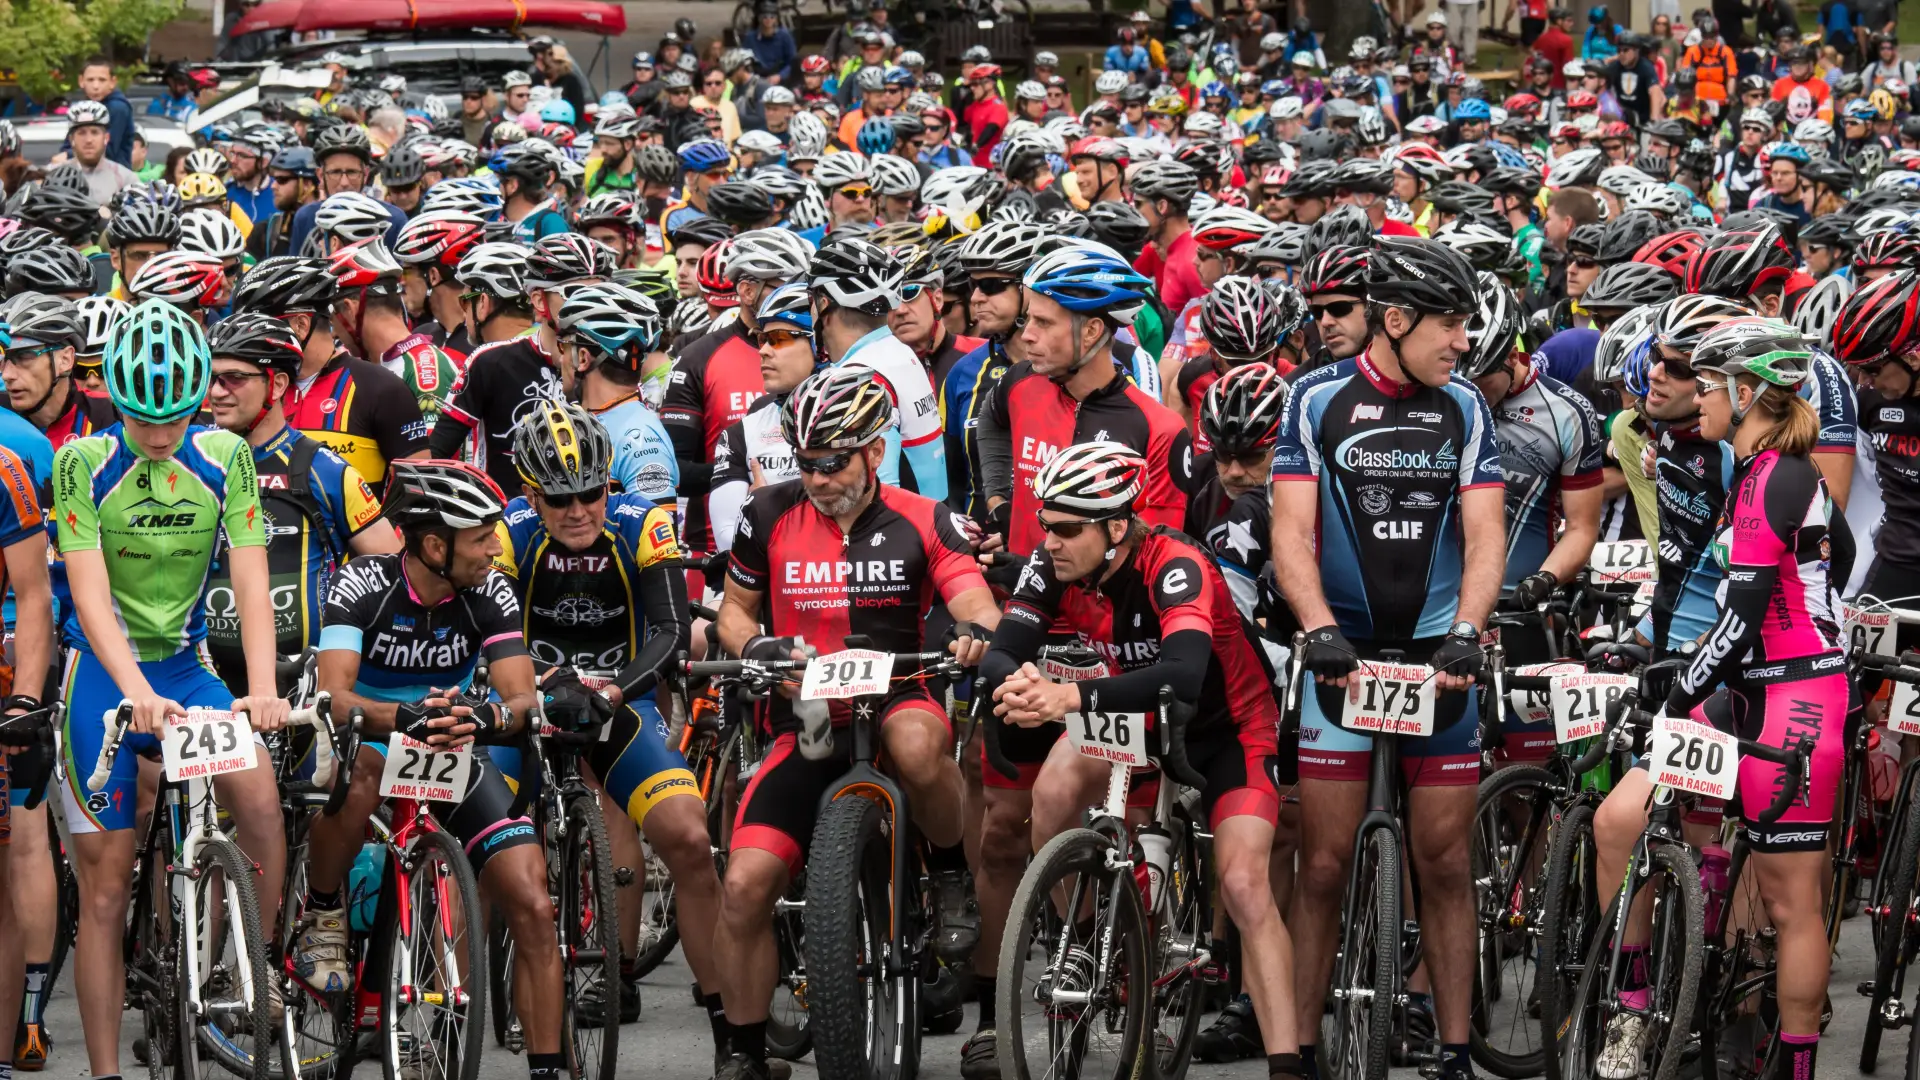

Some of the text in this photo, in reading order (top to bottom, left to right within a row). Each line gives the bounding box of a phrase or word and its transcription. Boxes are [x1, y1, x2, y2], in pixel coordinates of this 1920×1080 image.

[1403, 262, 1425, 279] GIRO
[633, 447, 658, 458] Group
[1347, 446, 1457, 470] ClassBook.com
[1364, 469, 1388, 477] ORDER
[127, 512, 196, 528] KMS
[503, 507, 538, 527] VERG
[1373, 521, 1423, 539] CLIF
[117, 546, 152, 560] Vittoria
[1605, 544, 1649, 568] 121
[493, 560, 515, 574] ERGY
[785, 559, 906, 584] EMPIRE
[1600, 572, 1651, 581] AMBA RACING
[782, 586, 839, 595] HANDCRAFTED
[882, 584, 911, 592] LAGERS
[794, 596, 902, 612] syracuse bicycle
[1010, 607, 1041, 624] bicycle
[1860, 612, 1890, 626] CHALLENGE
[369, 631, 470, 668] FinKraft
[850, 651, 884, 660] CHALLENGE
[1681, 608, 1746, 696] VERGE
[819, 660, 873, 684] 301
[1046, 662, 1064, 678] BLACK
[1064, 668, 1075, 680] FLY
[1360, 664, 1426, 682] BLACK FLY CHALLENGE
[1743, 665, 1786, 679] VERGE
[813, 683, 878, 698] AMBA RACING
[1561, 676, 1628, 689] BLACK FLY CHALLENGE
[1362, 679, 1421, 716] 175
[191, 712, 202, 723] FLY
[202, 711, 237, 722] CHALLENGE
[1353, 716, 1422, 733] AMBA RACING
[1080, 712, 1131, 747] 126
[1567, 722, 1592, 739] AMBA
[1664, 720, 1685, 732] BLACK
[1697, 726, 1729, 744] CHALLENGE
[1898, 720, 1920, 735] AMB
[176, 721, 238, 760] 243
[1080, 744, 1136, 764] AMBA RACING
[1666, 732, 1724, 776] 260
[179, 757, 246, 779] AMBA RACING
[397, 748, 459, 784] 212
[389, 784, 454, 800] AMBA RACING
[644, 777, 695, 800] VERGE
[1658, 771, 1723, 796] AMBA RACING
[482, 825, 535, 851] VERGE
[1766, 830, 1825, 844] VERGE
[1053, 925, 1069, 971] EASTON
[1099, 926, 1112, 973] EASTON
